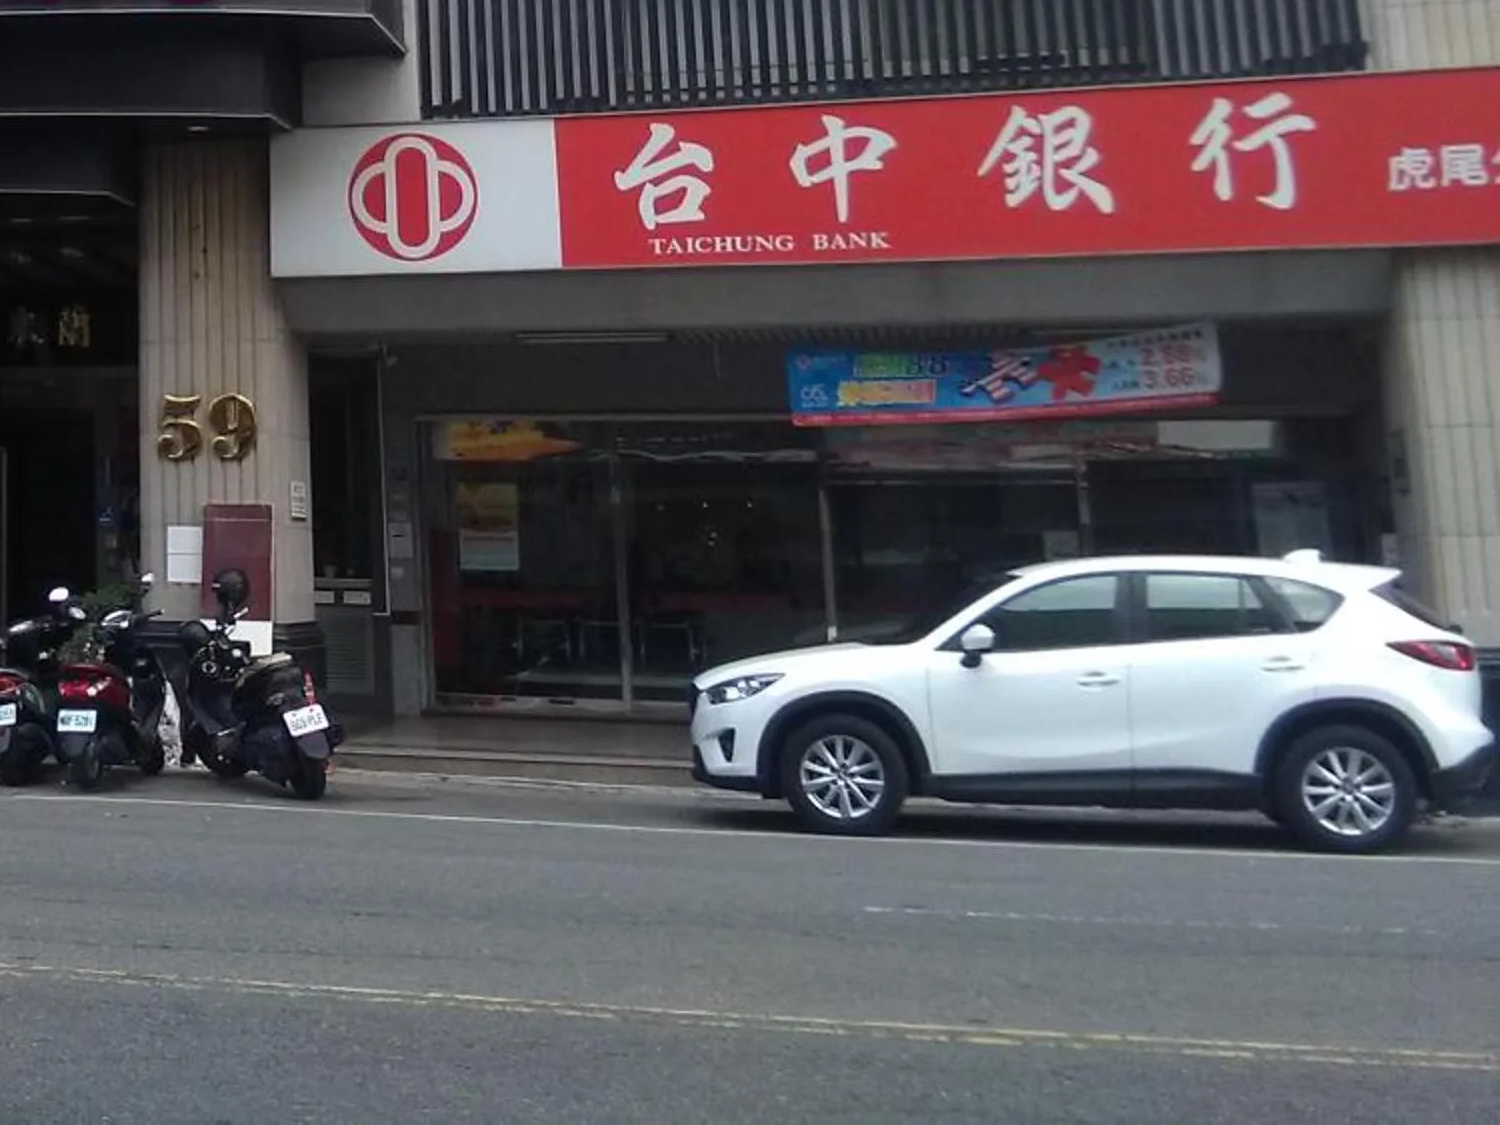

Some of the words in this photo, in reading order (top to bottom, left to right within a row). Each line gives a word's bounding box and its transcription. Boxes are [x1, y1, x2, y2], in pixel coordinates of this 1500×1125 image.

[613, 91, 1316, 231] 台中銀行
[1387, 143, 1500, 191] 虎尾
[648, 234, 795, 255] TAICHUNG
[812, 231, 891, 250] BANK
[157, 392, 258, 463] 59
